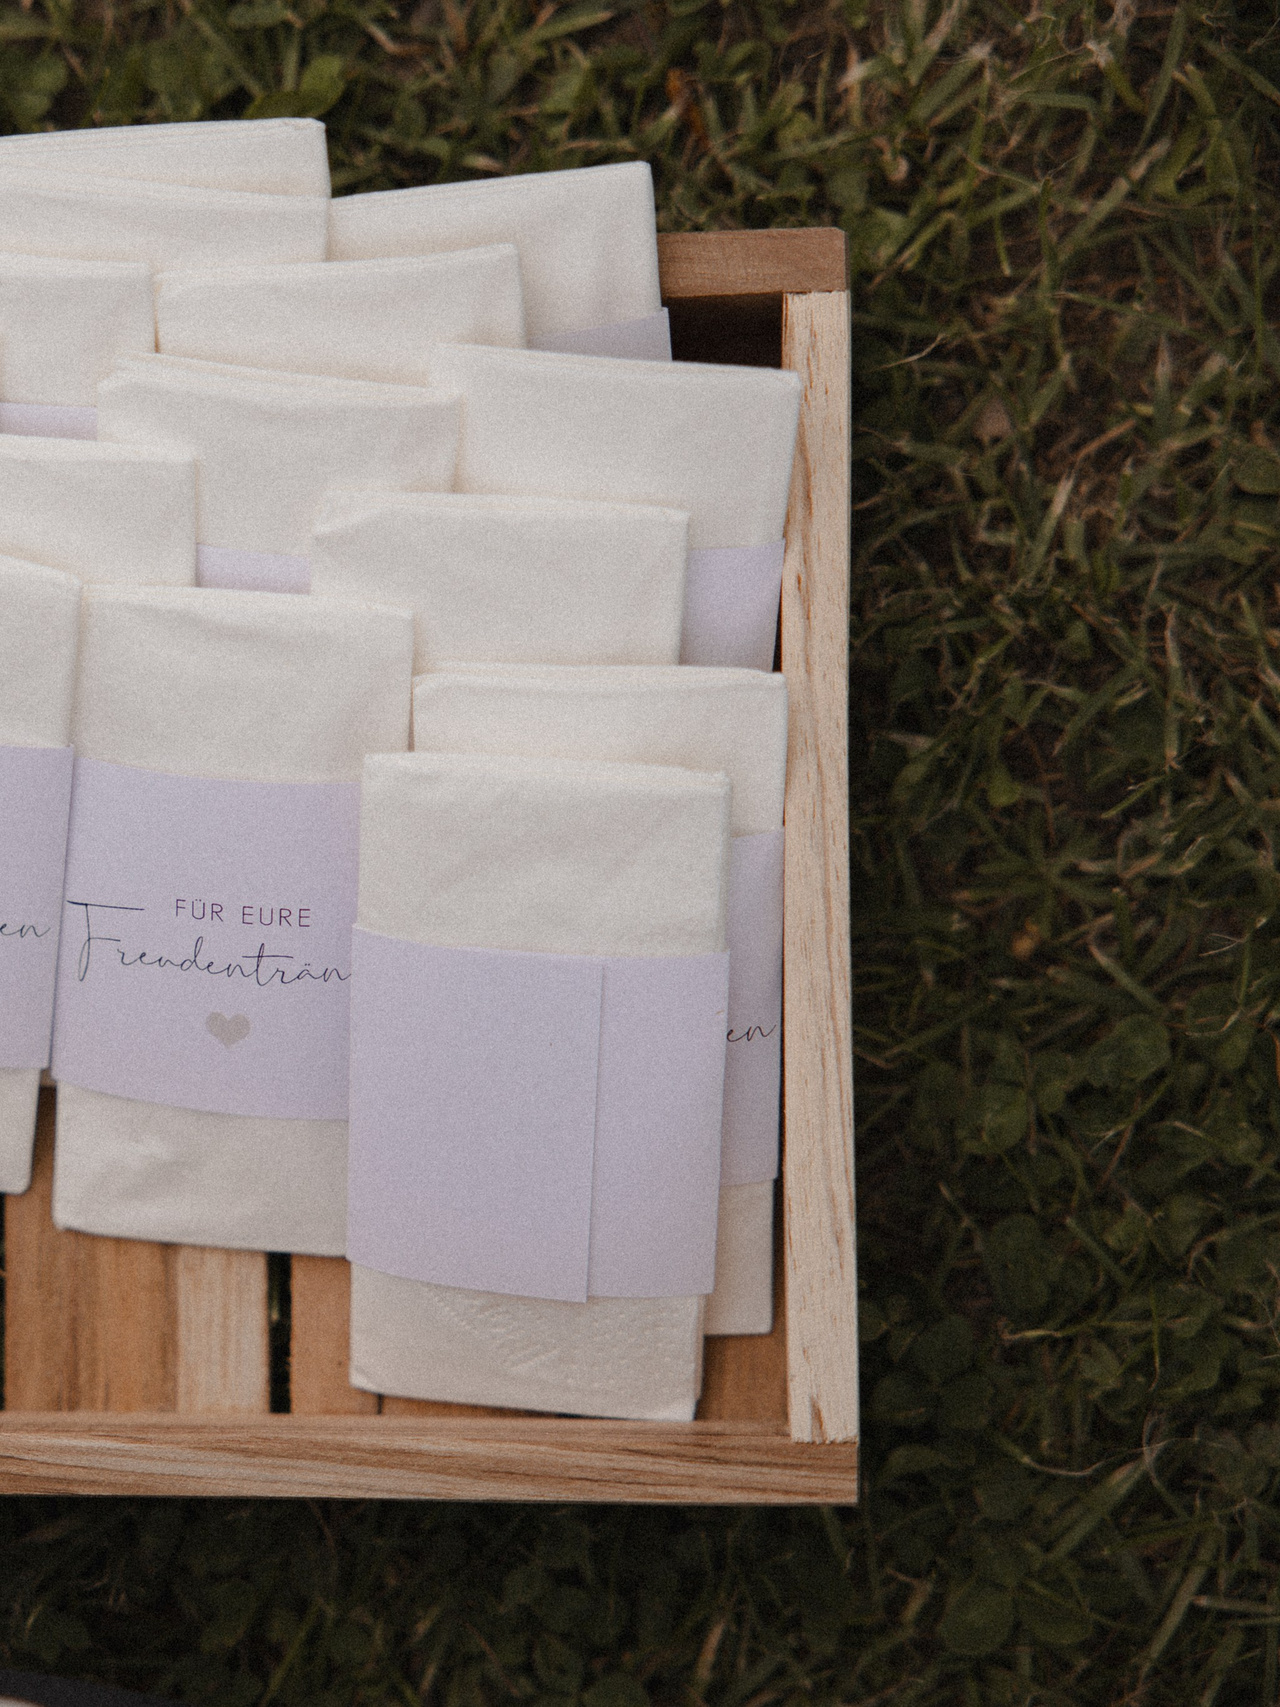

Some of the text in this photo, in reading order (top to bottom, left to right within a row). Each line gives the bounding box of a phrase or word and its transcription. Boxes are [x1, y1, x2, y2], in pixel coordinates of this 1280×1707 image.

[175, 898, 312, 928] FÜR EURE
[66, 899, 352, 987] Freudenträn
